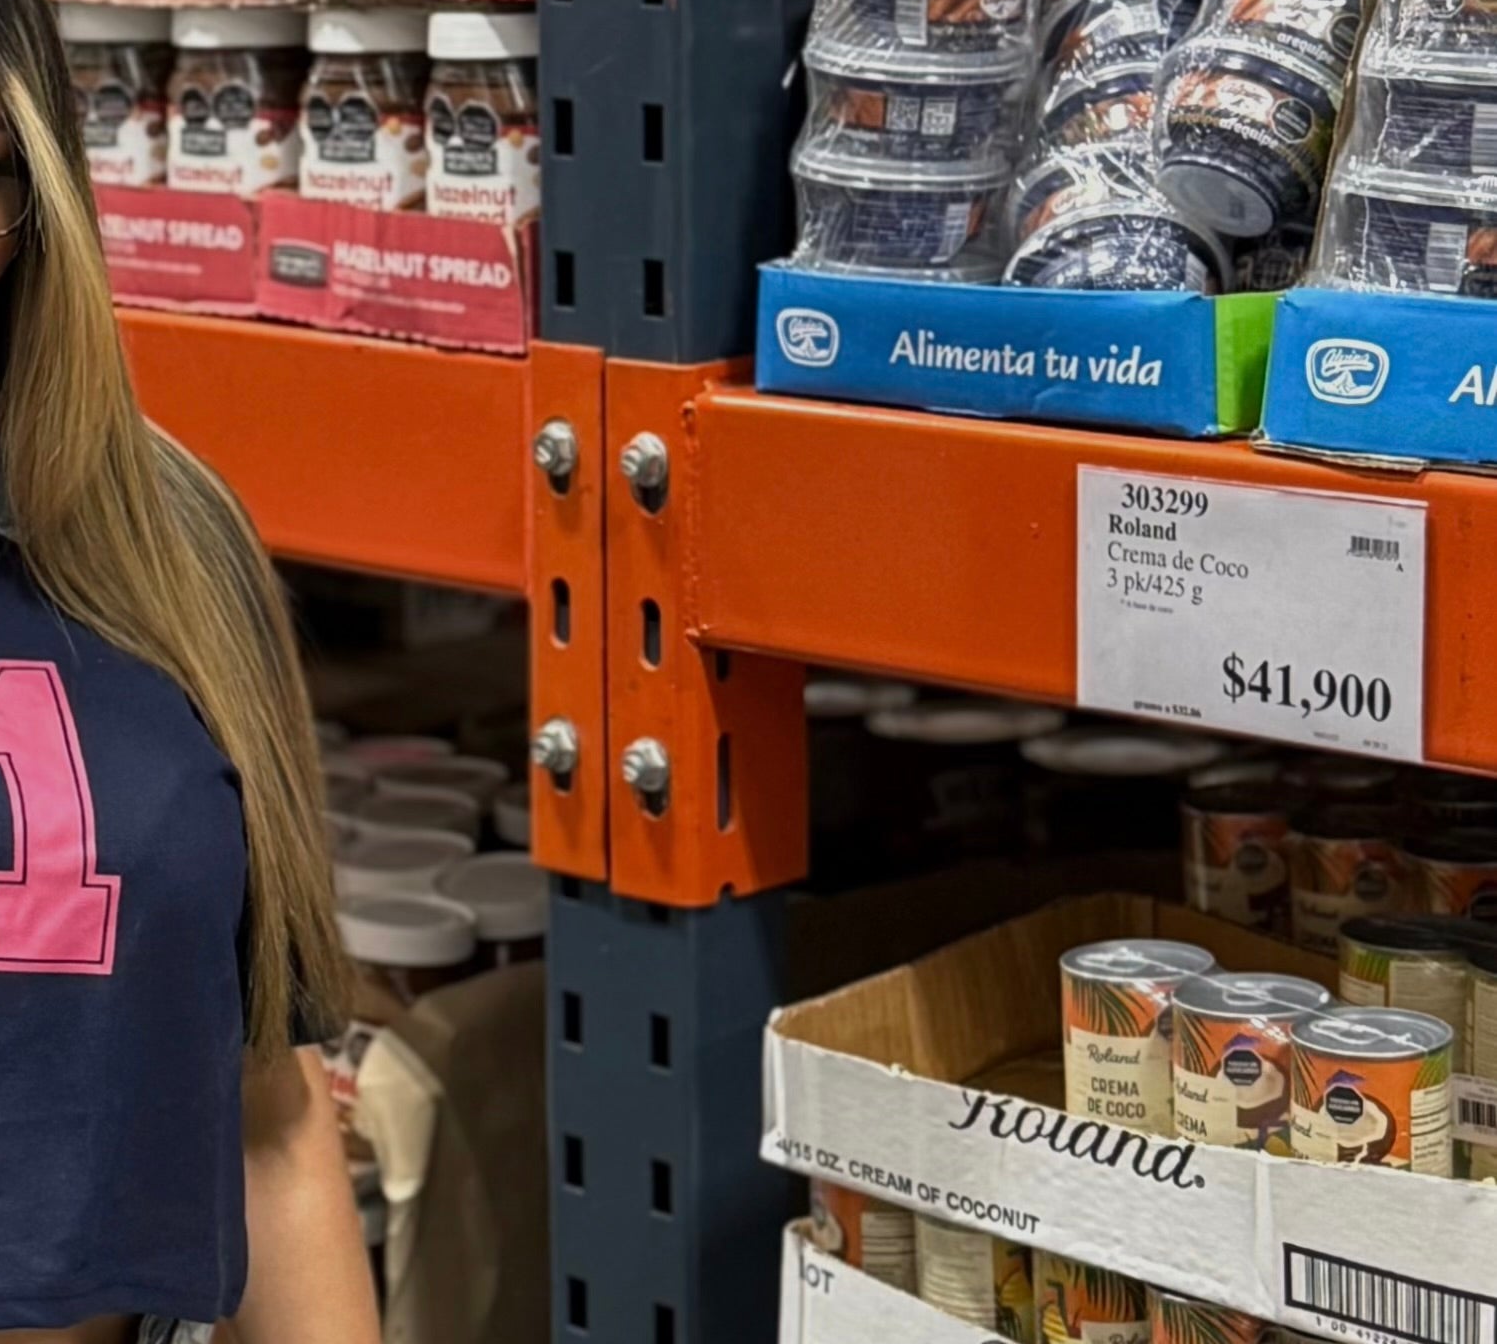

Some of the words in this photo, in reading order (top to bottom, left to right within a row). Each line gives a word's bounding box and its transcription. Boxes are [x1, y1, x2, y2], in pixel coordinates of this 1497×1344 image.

[167, 222, 244, 251] SPREAD
[333, 240, 427, 280] HAZELNUT
[428, 257, 511, 289] SPREAD
[889, 328, 1035, 377] Alimenta
[1045, 347, 1079, 381] tu
[1087, 343, 1163, 386] vida
[1120, 482, 1209, 518] 303299
[1107, 513, 1177, 542] Roland
[1106, 540, 1167, 571] Crema
[1171, 548, 1194, 572] de
[1199, 553, 1249, 579] Coco
[1106, 567, 1118, 589] 3
[1123, 570, 1185, 599] pk/425
[1191, 584, 1204, 606] g
[1221, 651, 1392, 724] $41,900
[1086, 1043, 1141, 1067] Roland
[1090, 1076, 1140, 1098] CREMA
[1087, 1097, 1103, 1116] DE
[1105, 1099, 1146, 1120] COCO
[815, 1148, 844, 1174] OZ.
[849, 1159, 913, 1198] CREAM
[917, 1182, 941, 1205] OF
[946, 1191, 1041, 1235] COCONUT
